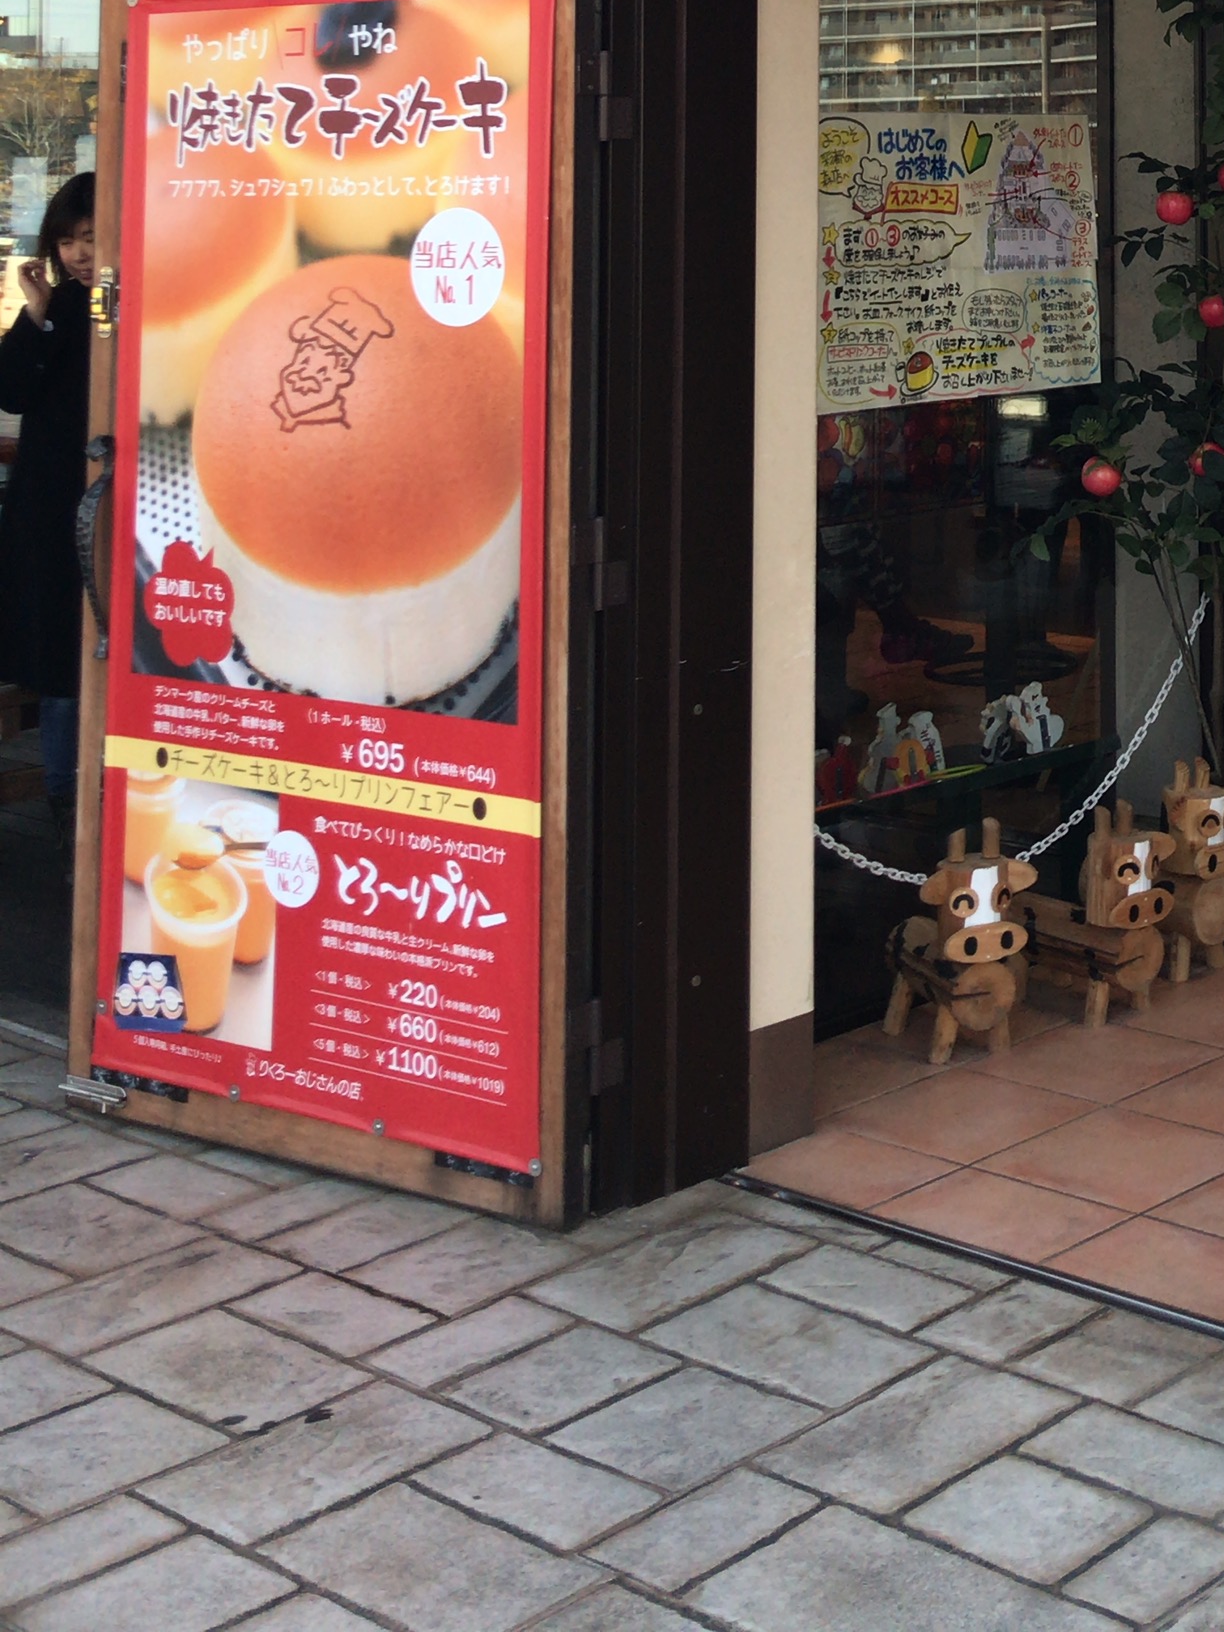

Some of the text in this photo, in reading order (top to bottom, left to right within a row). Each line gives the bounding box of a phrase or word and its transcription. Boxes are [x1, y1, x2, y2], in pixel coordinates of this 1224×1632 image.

[182, 27, 269, 64] やっぱり
[348, 21, 398, 56] やね
[167, 57, 509, 168] 焼きたてチーズケーキ
[821, 125, 861, 149] ようこそ
[877, 127, 948, 155] はじめての
[895, 152, 967, 182] お客様へ
[890, 186, 955, 207] オススメコース
[415, 240, 502, 270] 当店人気
[941, 352, 999, 370] チーズケーキを
[154, 576, 226, 602] 温め直しても
[153, 601, 227, 628] おいしいです
[153, 684, 277, 714] デンマーク産のクリームチーズと
[265, 848, 318, 876] 当店人気
[258, 1059, 363, 1101] りくろーおじさんの店
